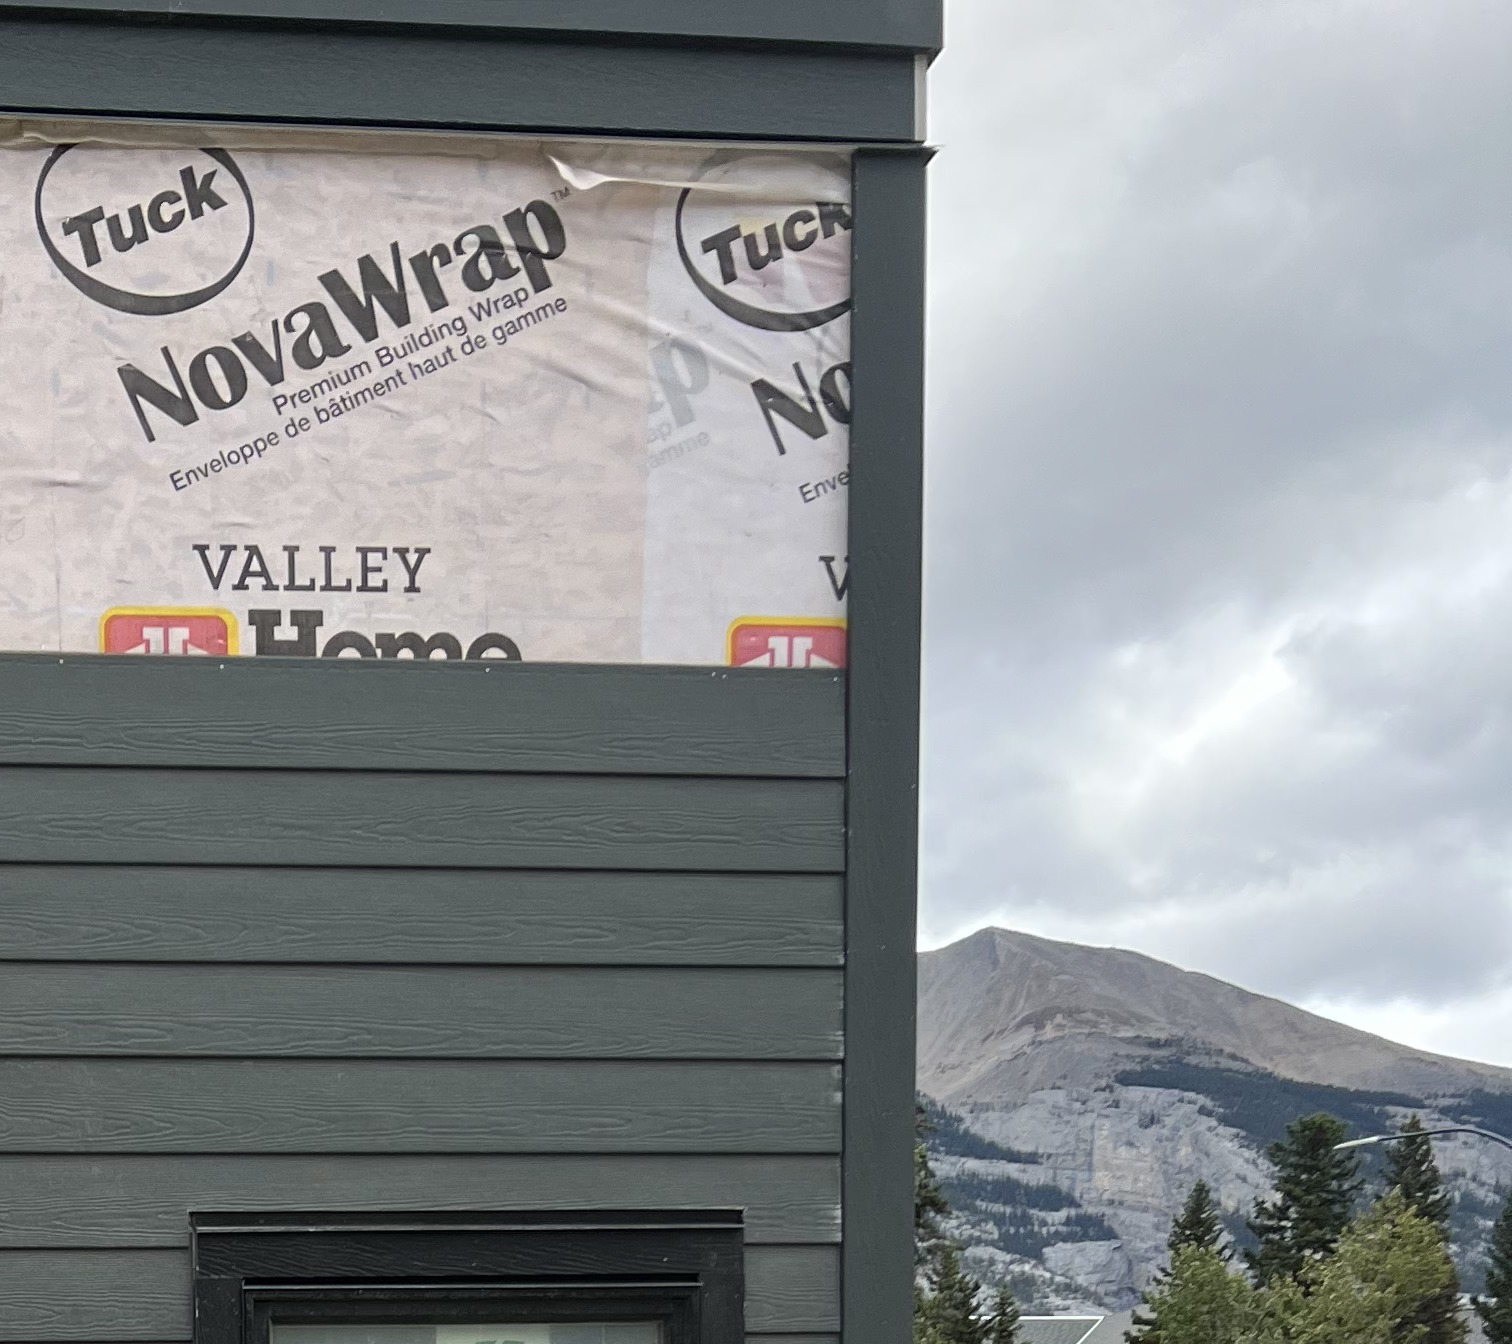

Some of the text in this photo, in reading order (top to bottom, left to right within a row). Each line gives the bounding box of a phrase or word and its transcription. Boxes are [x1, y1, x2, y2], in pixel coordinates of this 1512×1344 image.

[62, 165, 228, 268] Tuck
[169, 296, 568, 492] Enveloppe de bâtiment haut de gamme
[271, 287, 530, 416] Premium Building Wrap
[192, 544, 431, 593] VALLEY
